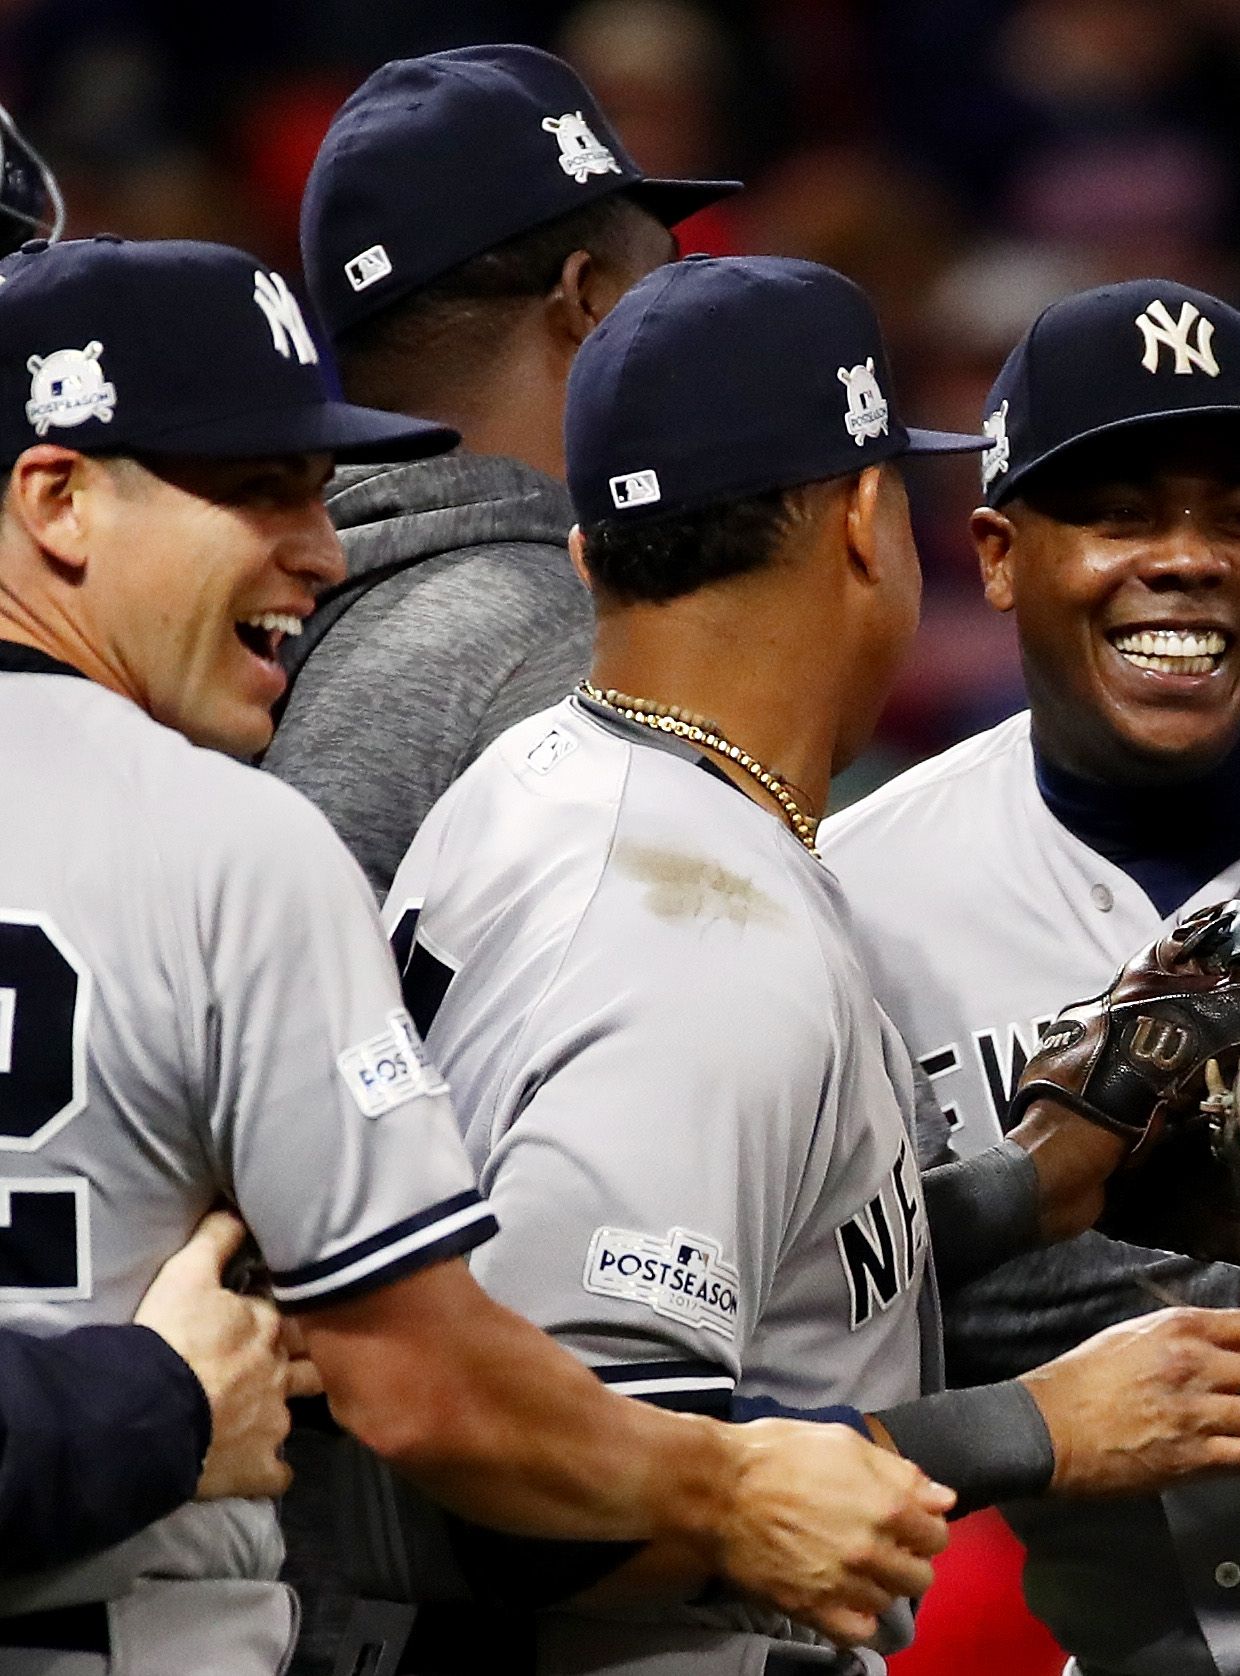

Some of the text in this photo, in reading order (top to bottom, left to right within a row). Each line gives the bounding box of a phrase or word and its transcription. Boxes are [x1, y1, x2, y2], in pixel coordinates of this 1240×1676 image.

[1135, 299, 1220, 377] NY
[835, 1138, 924, 1332] NE
[599, 1249, 738, 1317] POSTSEASON
